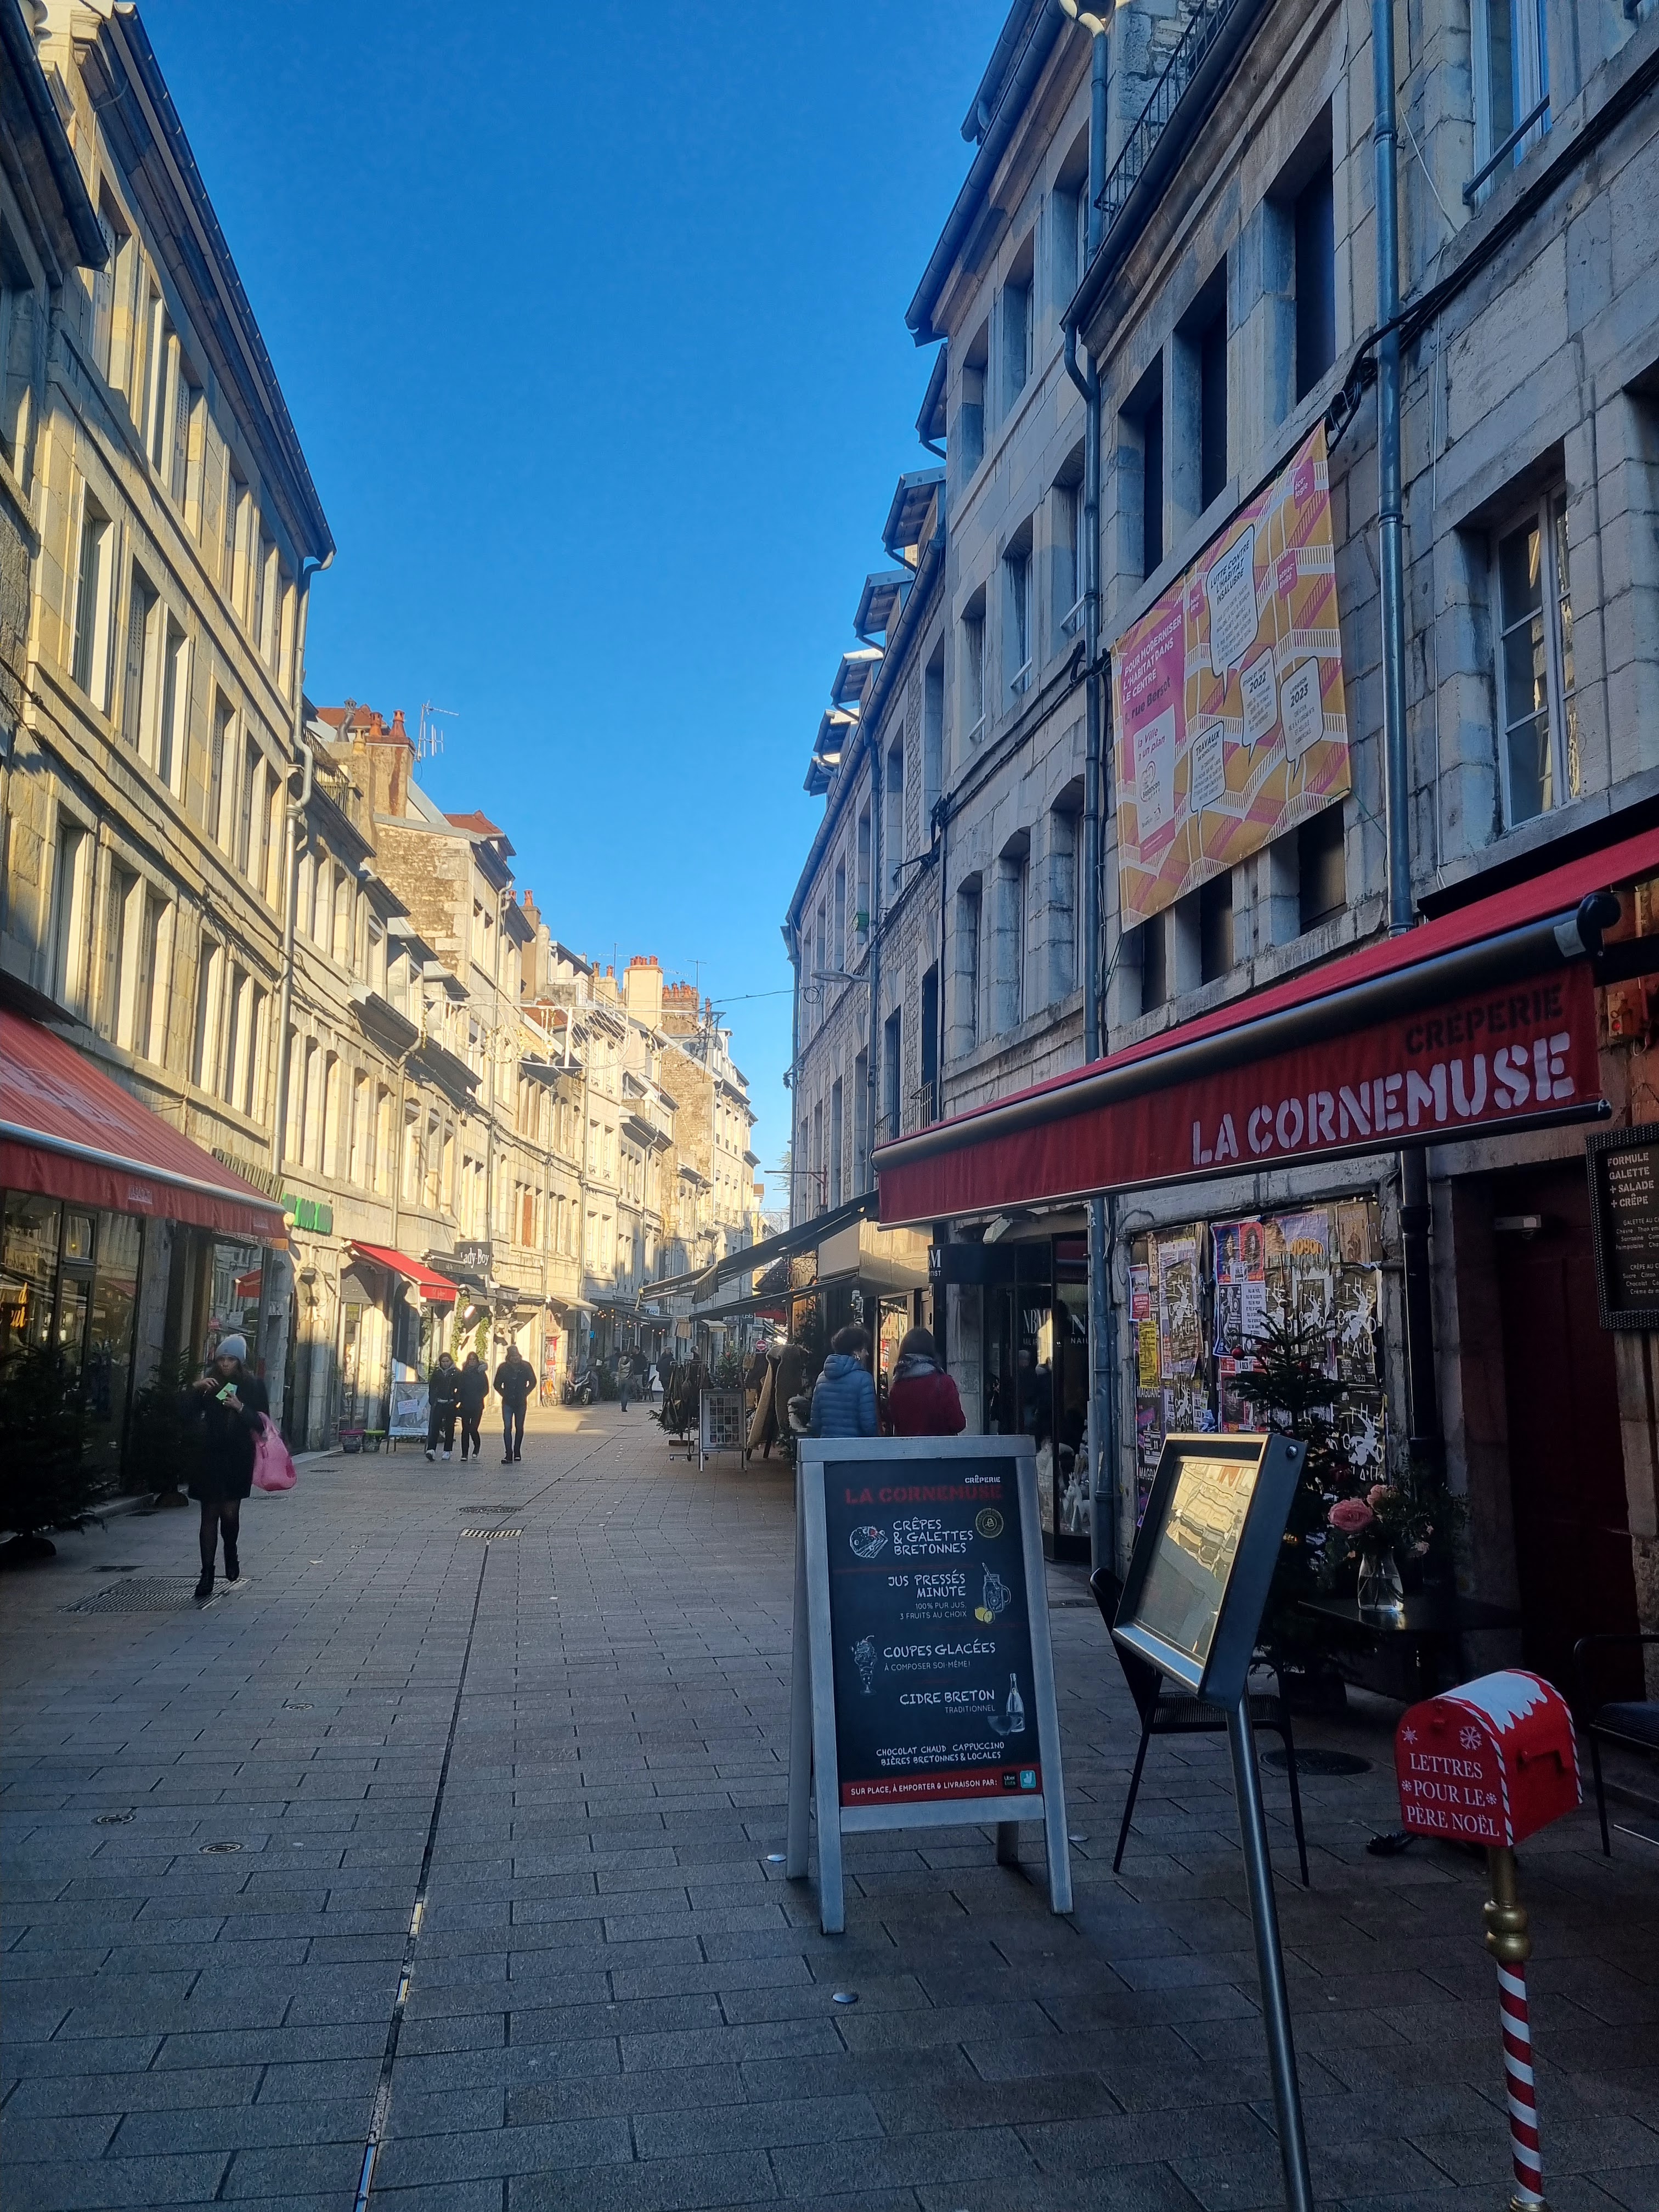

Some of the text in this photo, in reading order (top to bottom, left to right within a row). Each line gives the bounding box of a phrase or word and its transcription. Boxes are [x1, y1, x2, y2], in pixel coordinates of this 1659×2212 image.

[1211, 566, 1226, 590] LUTTE
[1228, 539, 1250, 569] CONTRE
[1216, 557, 1244, 594] L'HABITAT
[1217, 567, 1244, 606] INSALUBRE
[1125, 614, 1182, 676] POUR MODERNISER
[1123, 637, 1173, 690] L'HABITAT DANS
[1123, 668, 1156, 705] LE CENTRE
[1249, 670, 1266, 694] 2022
[1131, 701, 1145, 718] rue
[1147, 676, 1171, 707] Bersot
[1290, 683, 1308, 708] 2023
[1137, 727, 1158, 749] la Ville
[1142, 745, 1150, 758] un
[1150, 735, 1165, 753] plan
[1196, 729, 1220, 756] TRAVAUX
[1193, 1031, 1575, 1165] LA CORNEMUSE
[1607, 1153, 1649, 1167] FORMULE
[1609, 1166, 1650, 1180] GALETTE
[1618, 1180, 1654, 1193] SALADE
[1620, 1193, 1649, 1207] CRÊPE
[928, 1249, 941, 1268] M
[1344, 1277, 1373, 1306] THE
[1154, 1440, 1158, 1449] 11
[964, 1475, 1001, 1483] CRÊPERIE
[845, 1485, 1003, 1504] LA CORNEMUSE
[893, 1516, 942, 1531] CRÊPES
[893, 1531, 902, 1544] &
[906, 1530, 974, 1542] GALETTES
[894, 1543, 966, 1556] BRETONNES
[888, 1569, 966, 1587] JUS PRESSÉS
[917, 1586, 966, 1598] MINUTE
[883, 1638, 996, 1658] COUPES GLACÉES
[884, 1663, 889, 1671] À
[891, 1662, 931, 1671] COMPOSER
[900, 1689, 995, 1705] CIDRE BRETON
[945, 1705, 995, 1713] TRADITIONNEL
[876, 1741, 1005, 1757] CHOCOLAT CHAUD CAPPUCCINO
[881, 1751, 1001, 1766] BIÈRES BRETONNES & LOCALES
[1410, 1753, 1482, 1779] LETTRES
[851, 1787, 865, 1796] SUR
[867, 1786, 891, 1795] PLACE,
[893, 1783, 898, 1792] À
[899, 1782, 935, 1792] EMPORTER
[944, 1780, 980, 1789] LIVRAISON
[1414, 1780, 1485, 1807] POUR LE
[1407, 1802, 1500, 1837] PÈRE NOËL
